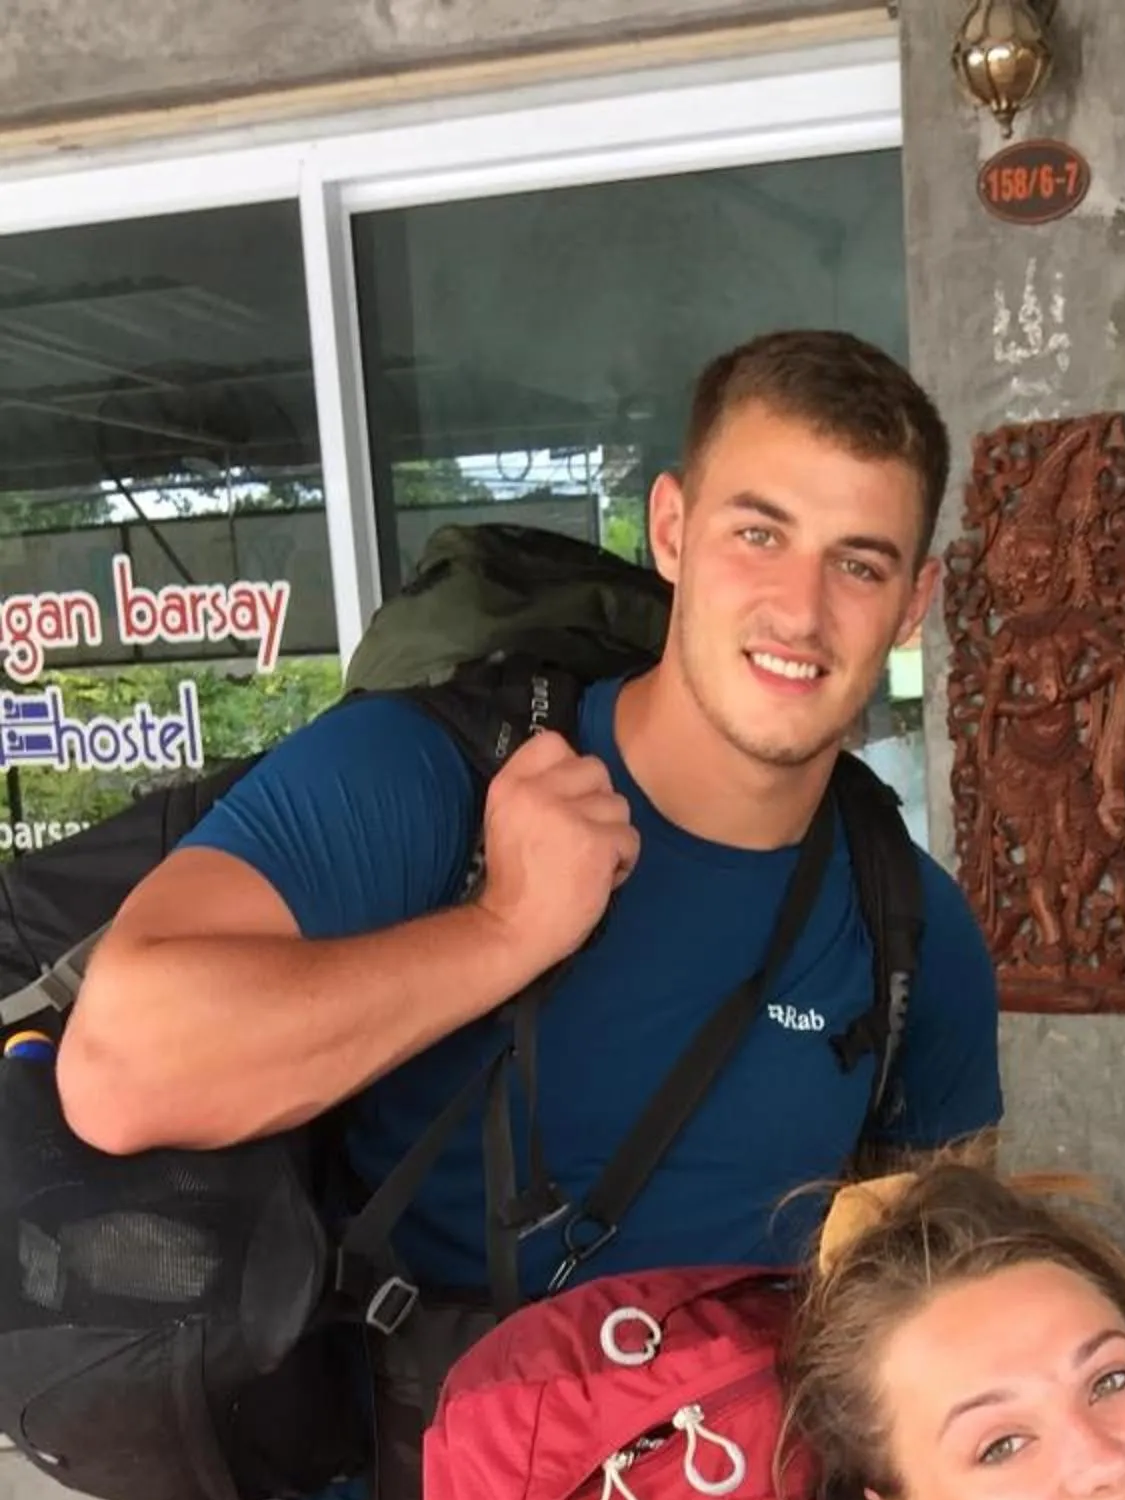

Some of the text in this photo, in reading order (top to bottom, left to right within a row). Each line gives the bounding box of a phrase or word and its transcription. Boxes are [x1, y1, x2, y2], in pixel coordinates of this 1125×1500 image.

[985, 160, 1079, 202] 158/6-7
[0, 555, 290, 682] gan barsay
[53, 681, 203, 770] hostel
[0, 820, 97, 850] arsa
[783, 1003, 826, 1031] Rab
